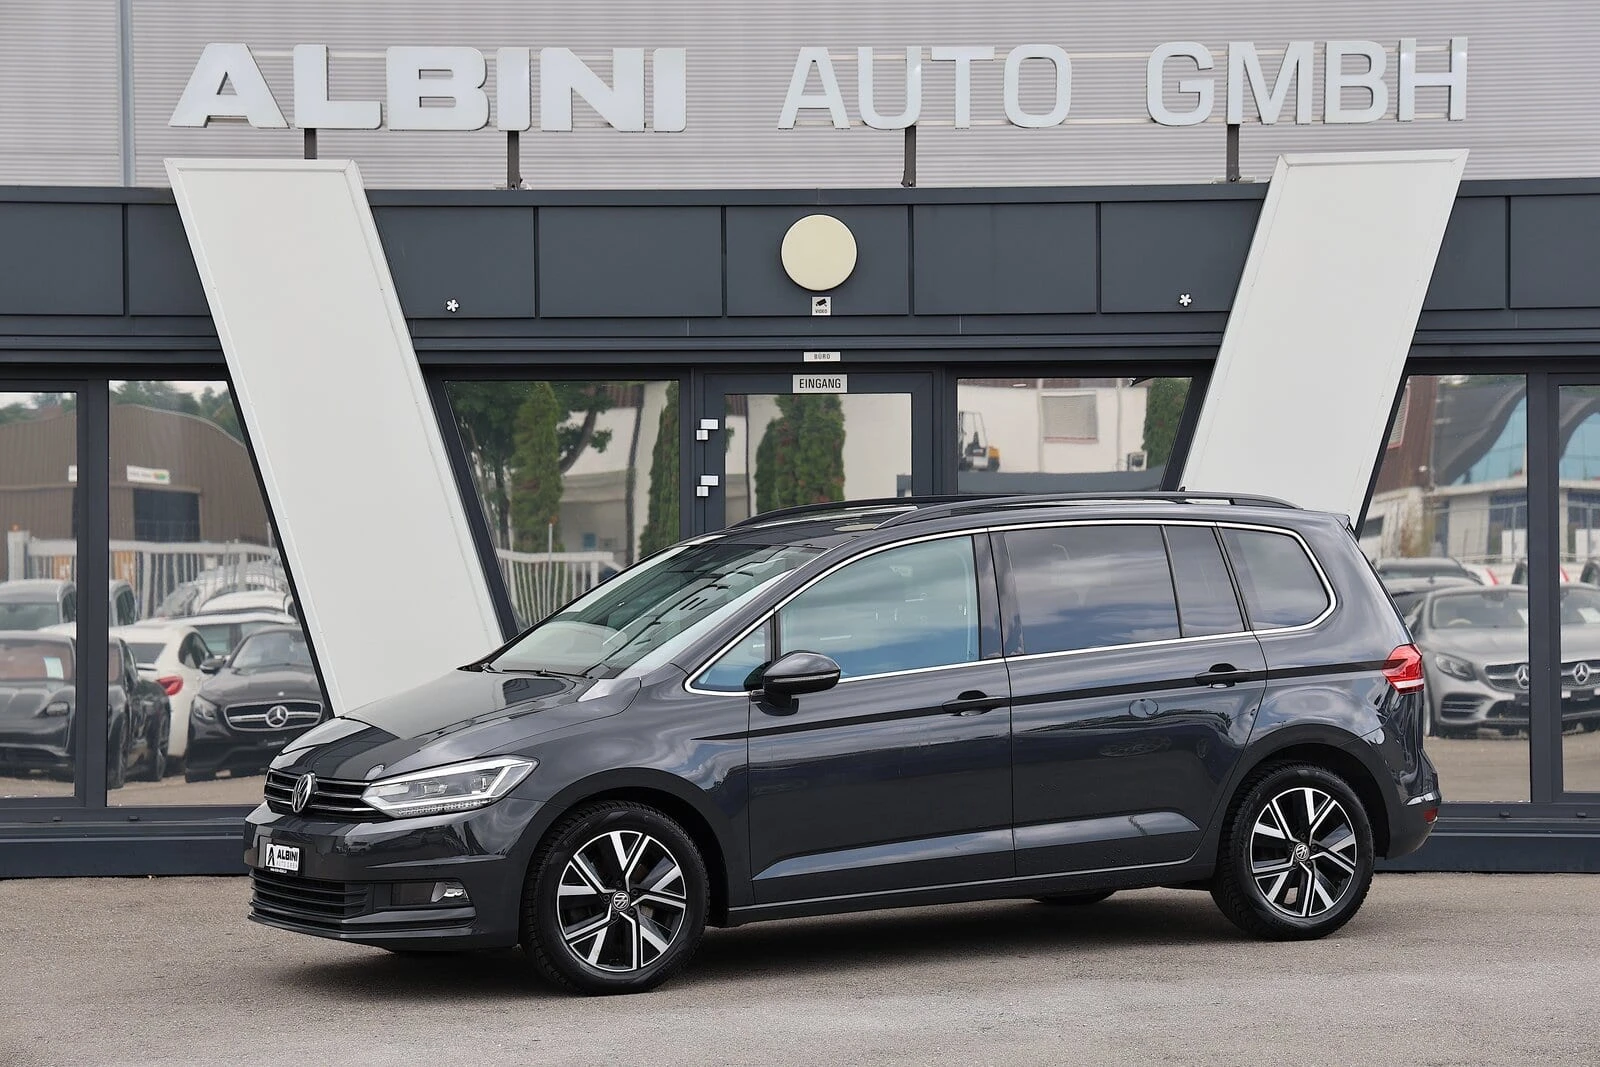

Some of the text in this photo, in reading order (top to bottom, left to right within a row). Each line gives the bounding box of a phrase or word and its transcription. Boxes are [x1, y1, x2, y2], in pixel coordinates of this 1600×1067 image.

[168, 36, 1468, 133] ALBINI AUTO GMBH
[799, 378, 841, 389] EINGANG
[277, 849, 298, 861] ALBINI
